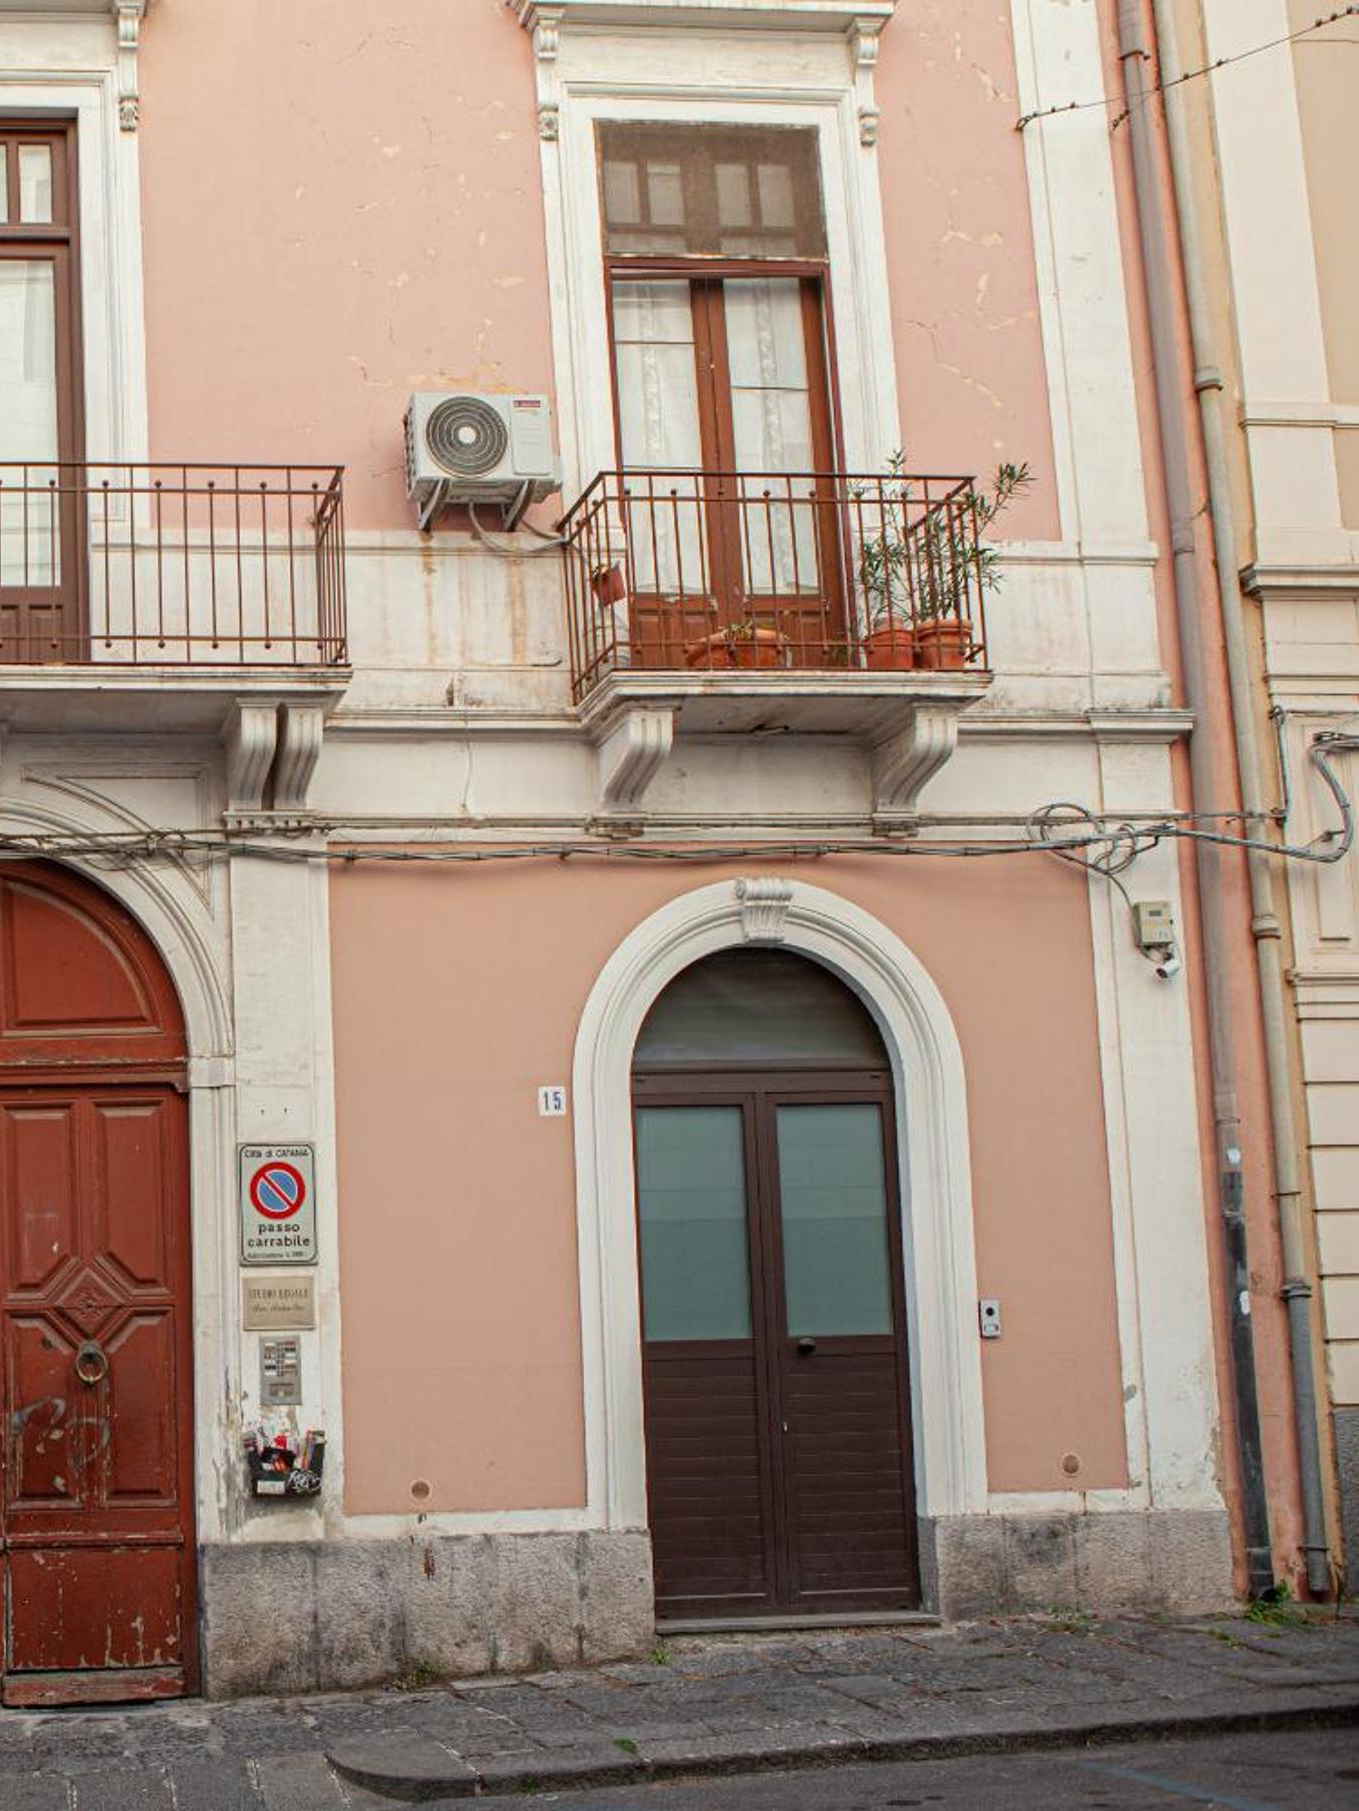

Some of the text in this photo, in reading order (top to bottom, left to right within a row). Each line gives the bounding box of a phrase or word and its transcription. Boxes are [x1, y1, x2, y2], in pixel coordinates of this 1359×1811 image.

[544, 1091, 561, 1111] 15
[258, 1223, 300, 1235] passo
[247, 1235, 310, 1247] carrabile
